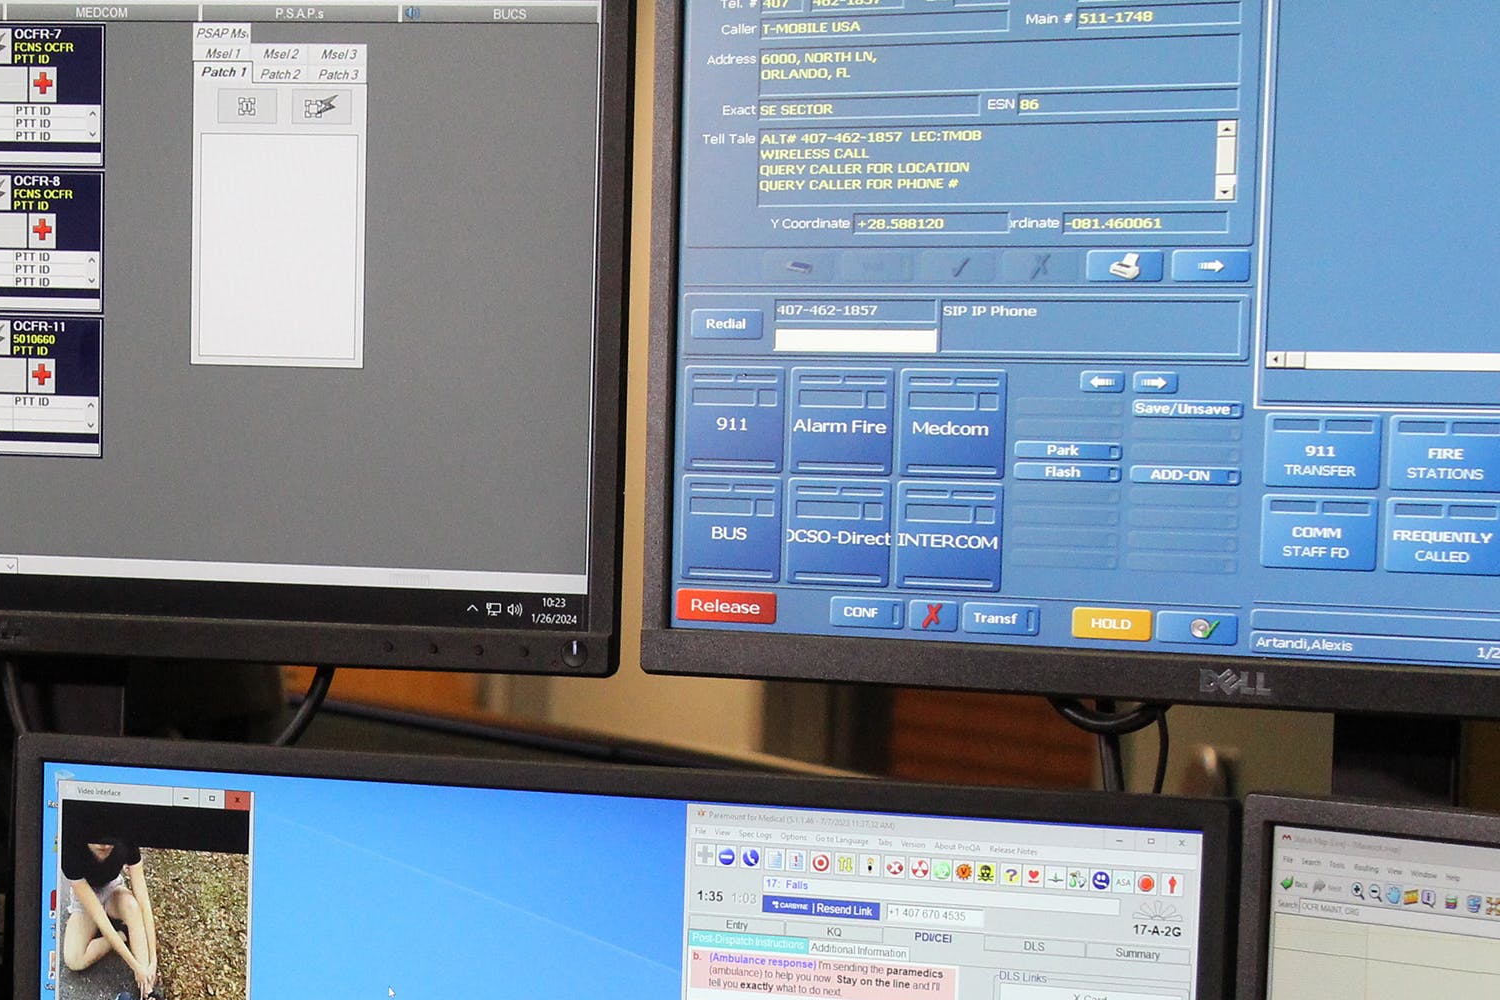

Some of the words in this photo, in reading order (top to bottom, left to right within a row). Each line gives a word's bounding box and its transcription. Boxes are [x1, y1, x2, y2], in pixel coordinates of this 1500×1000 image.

[76, 8, 128, 18] MEDCOM
[493, 9, 527, 20] BUCS
[1026, 14, 1058, 24] Main
[1063, 13, 1072, 24] #
[1079, 11, 1153, 24] 511-1748
[721, 24, 756, 34] Caller
[763, 22, 828, 33] T-MOBILE
[832, 21, 860, 32] USA
[14, 29, 61, 39] OCFR-7
[14, 42, 41, 52] FCNS
[44, 43, 73, 52] OCFR
[707, 54, 756, 64] Address
[761, 52, 801, 66] 6000,
[804, 52, 851, 63] NORTH
[855, 52, 877, 64] LN,
[202, 67, 238, 78] Patch
[241, 67, 247, 78] 1
[761, 68, 832, 81] ORLANDO,
[836, 68, 850, 78] FL
[722, 105, 756, 115] Exact
[760, 104, 777, 115] SE
[781, 104, 833, 115] SECTOR
[988, 99, 1015, 109] ESN
[1019, 99, 1039, 110] 86
[703, 134, 727, 144] Tell
[730, 134, 755, 144] Tale
[761, 132, 796, 144] ALT#
[801, 131, 902, 144] 407-462-1857
[911, 131, 982, 142] LEC:TMOB
[760, 149, 830, 160] WIRELESS
[834, 148, 868, 159] CALL
[771, 219, 778, 229] Y
[782, 218, 850, 229] Coordinate
[857, 219, 944, 230] +28.588120
[1009, 218, 1059, 229] rdinate
[1065, 218, 1162, 230] -081.460061
[777, 305, 878, 316] 407-462-1857
[943, 306, 968, 316] SIP
[972, 306, 986, 316] IP
[991, 305, 1037, 316] Phone
[13, 321, 65, 332] OCFR-11
[706, 319, 745, 329] Redial
[1135, 402, 1230, 417] Save/Unsave
[716, 418, 748, 431] 911
[793, 419, 848, 434] Alarm
[852, 420, 887, 434] Fire
[912, 421, 989, 436] Medcom
[1047, 445, 1079, 457] Park
[1305, 445, 1336, 458] 911
[1428, 447, 1463, 460] FIRE
[1045, 466, 1080, 478] Flash
[1150, 469, 1210, 481] ADD-ON
[1284, 464, 1356, 477] TRANSFER
[1407, 467, 1484, 480] STATIONS
[711, 527, 747, 541] BUS
[1292, 527, 1341, 539] COMM
[1393, 530, 1492, 545] FREQUENTLY
[898, 534, 998, 549] INTERCOM
[1283, 545, 1326, 558] STAFF
[1330, 546, 1348, 559] FD
[1415, 550, 1469, 564] CALLED
[543, 598, 565, 608] 10:23
[691, 599, 760, 614] Release
[532, 613, 577, 624] 1/26/2024
[844, 607, 878, 618] CONF
[974, 612, 1017, 624] Transf
[1091, 617, 1131, 630] HOLD
[1256, 636, 1352, 653] Artandi,Alexis
[1200, 669, 1271, 695] DELL
[697, 890, 723, 902] 1:35
[817, 903, 851, 915] Resend
[854, 905, 872, 917] Link
[726, 919, 748, 932] Entry
[1133, 924, 1181, 937] 17-A-2G
[827, 927, 842, 938] KQ
[1024, 941, 1045, 952] DLS
[1116, 947, 1160, 961] Summary
